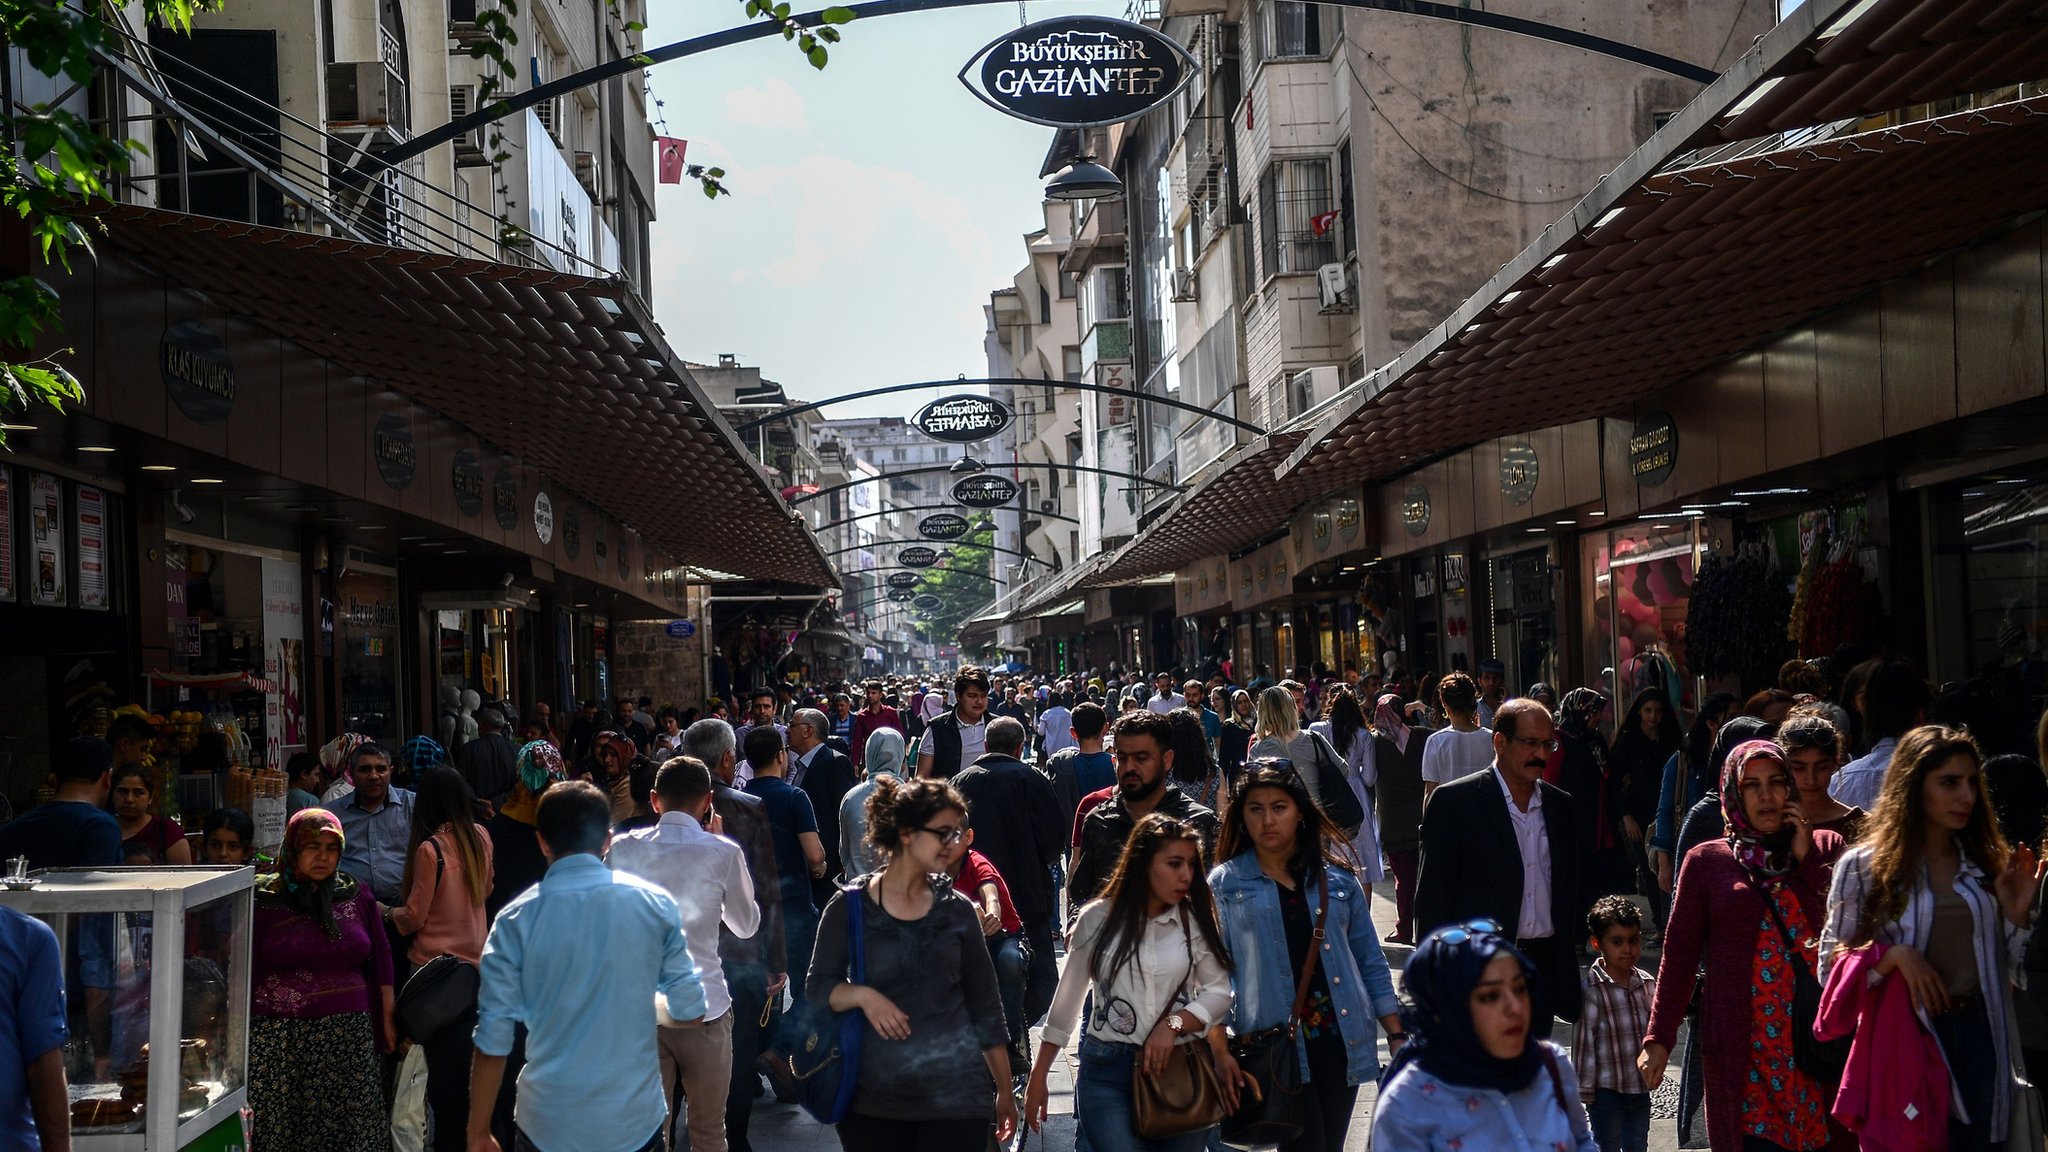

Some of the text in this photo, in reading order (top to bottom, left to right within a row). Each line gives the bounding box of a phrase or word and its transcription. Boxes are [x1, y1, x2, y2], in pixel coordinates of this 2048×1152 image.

[1010, 40, 1151, 64] BÜYÜKŞEHİR
[995, 64, 1164, 97] GAZİANTEP
[168, 344, 234, 400] KLAS KUYUMCU
